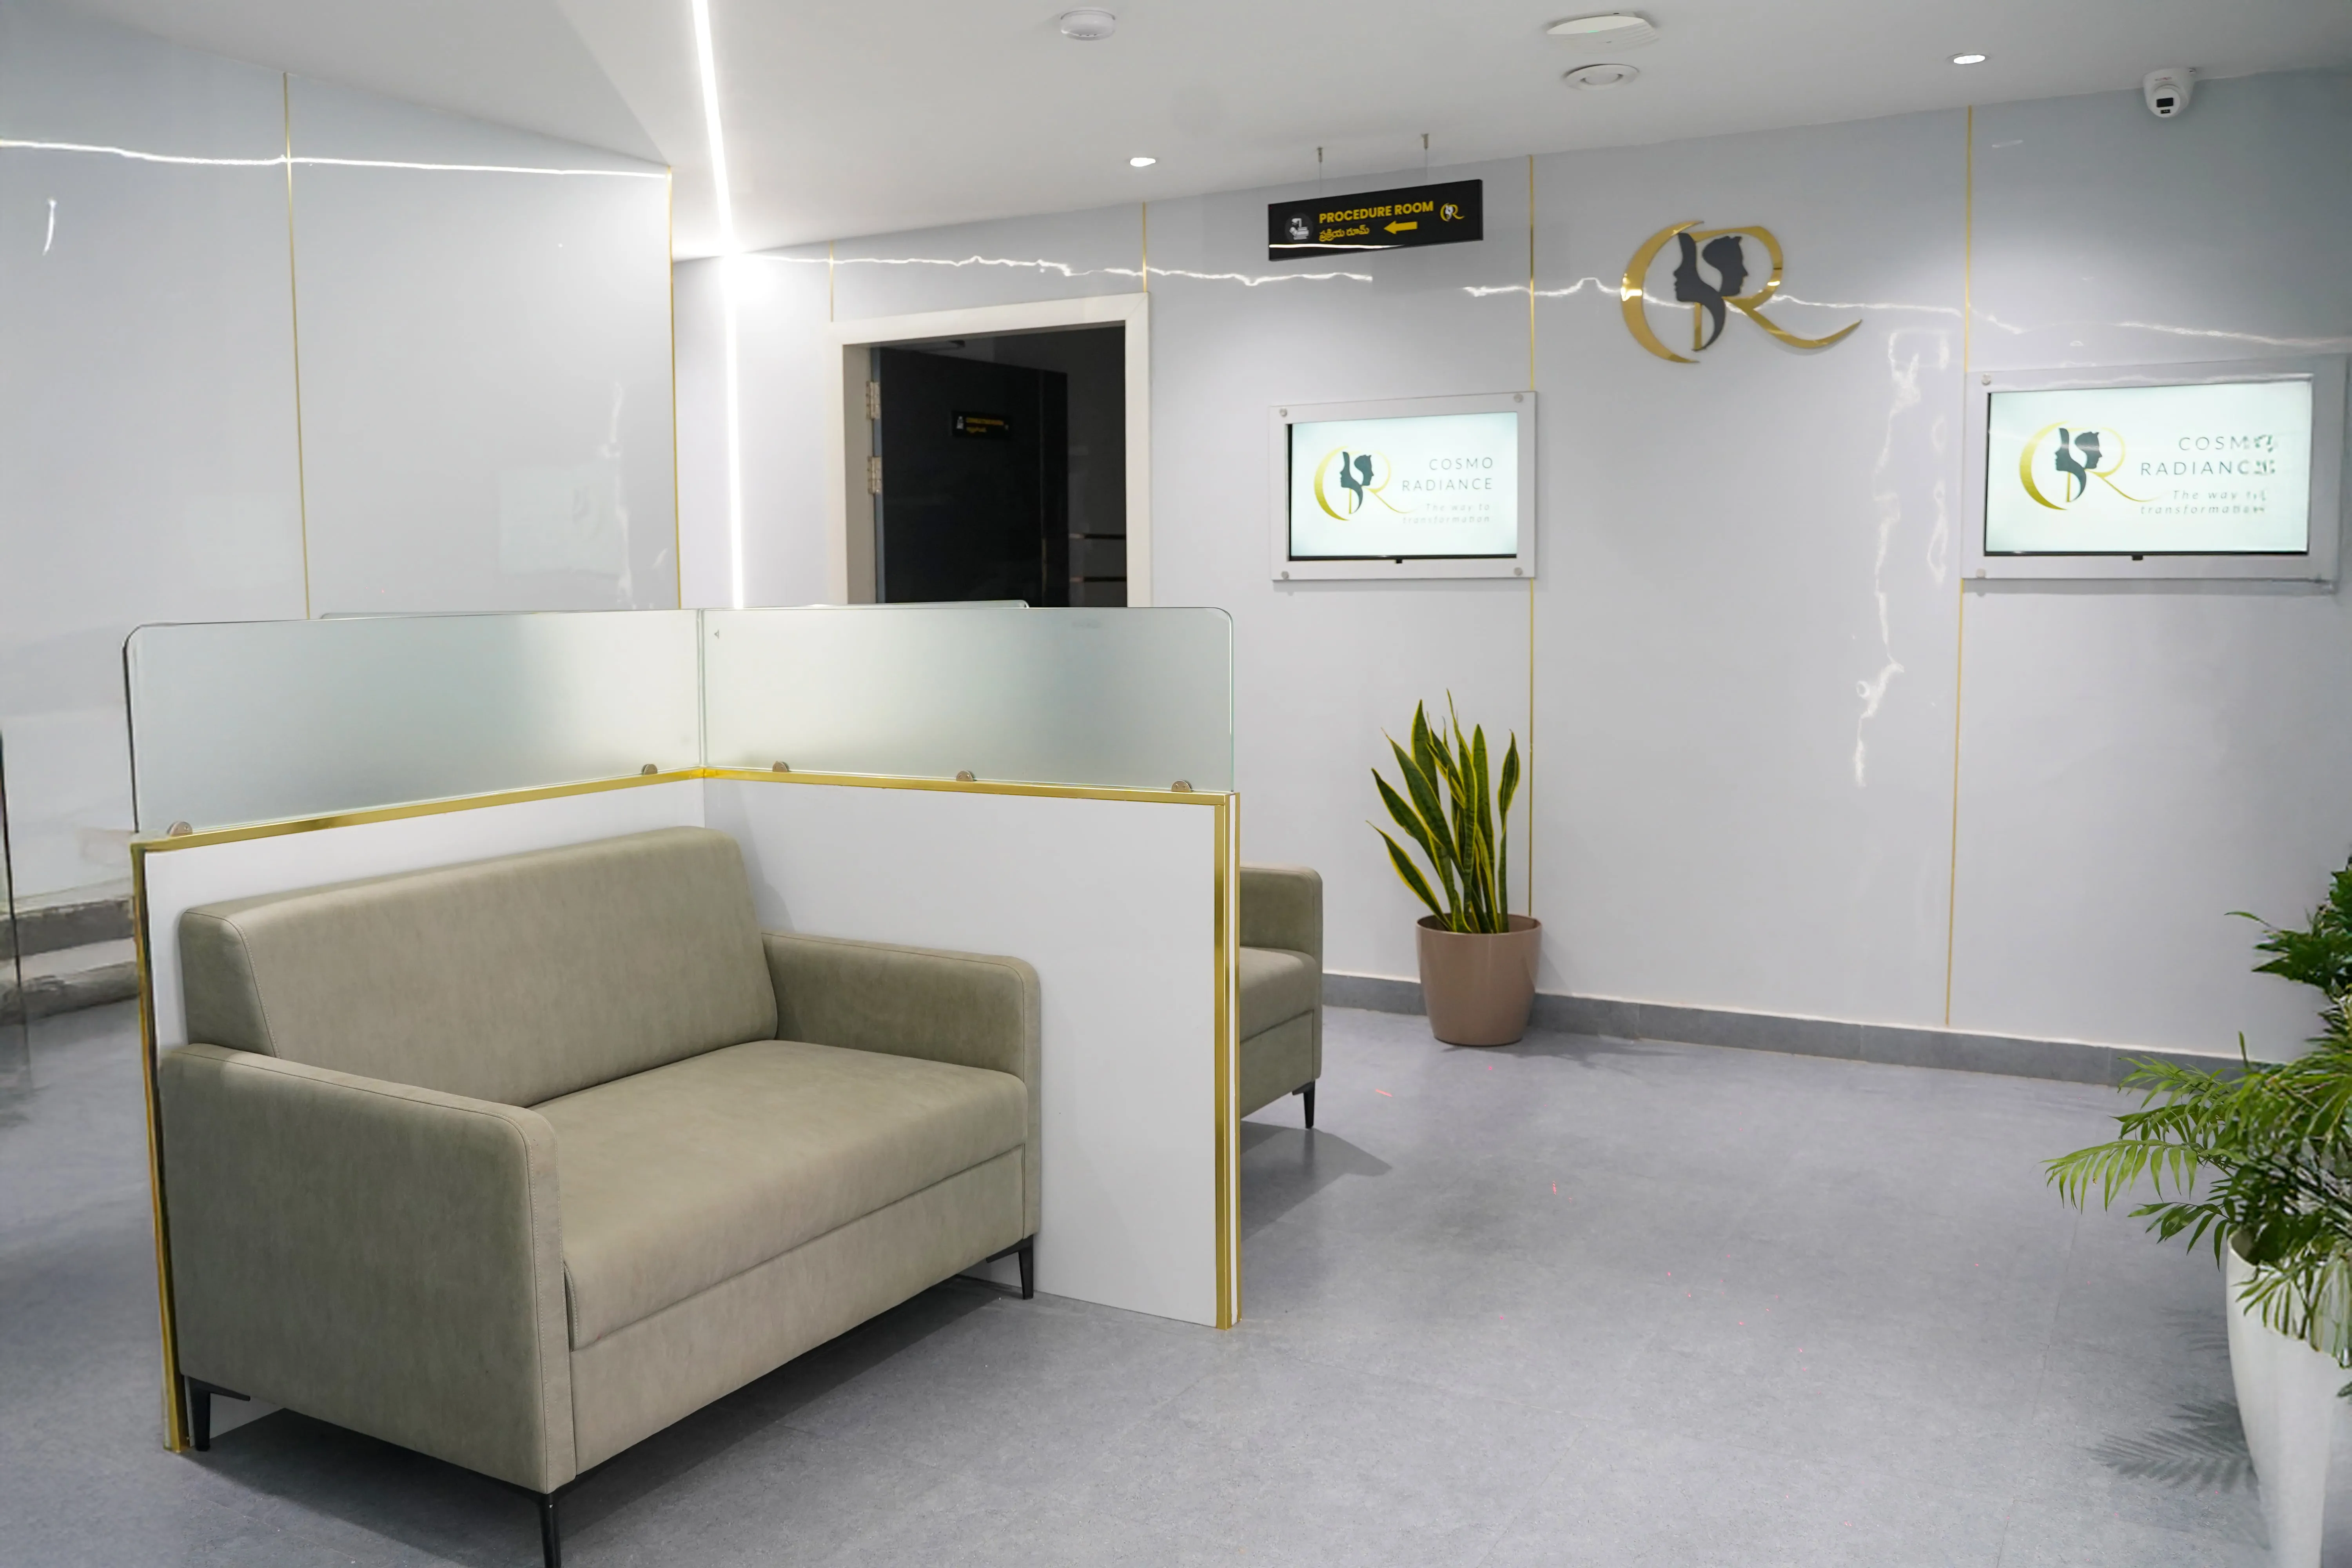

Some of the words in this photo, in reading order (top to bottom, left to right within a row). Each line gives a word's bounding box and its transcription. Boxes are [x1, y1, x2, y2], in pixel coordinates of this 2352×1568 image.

[1319, 205, 1392, 224] PROCEDURE
[1394, 201, 1434, 215] ROOM
[1429, 457, 1493, 470] COSMO
[1402, 477, 1492, 491] RADIANCE
[2173, 490, 2198, 500] The
[2208, 491, 2238, 501] way
[1426, 503, 1445, 511] The
[1403, 515, 1490, 524] transformation
